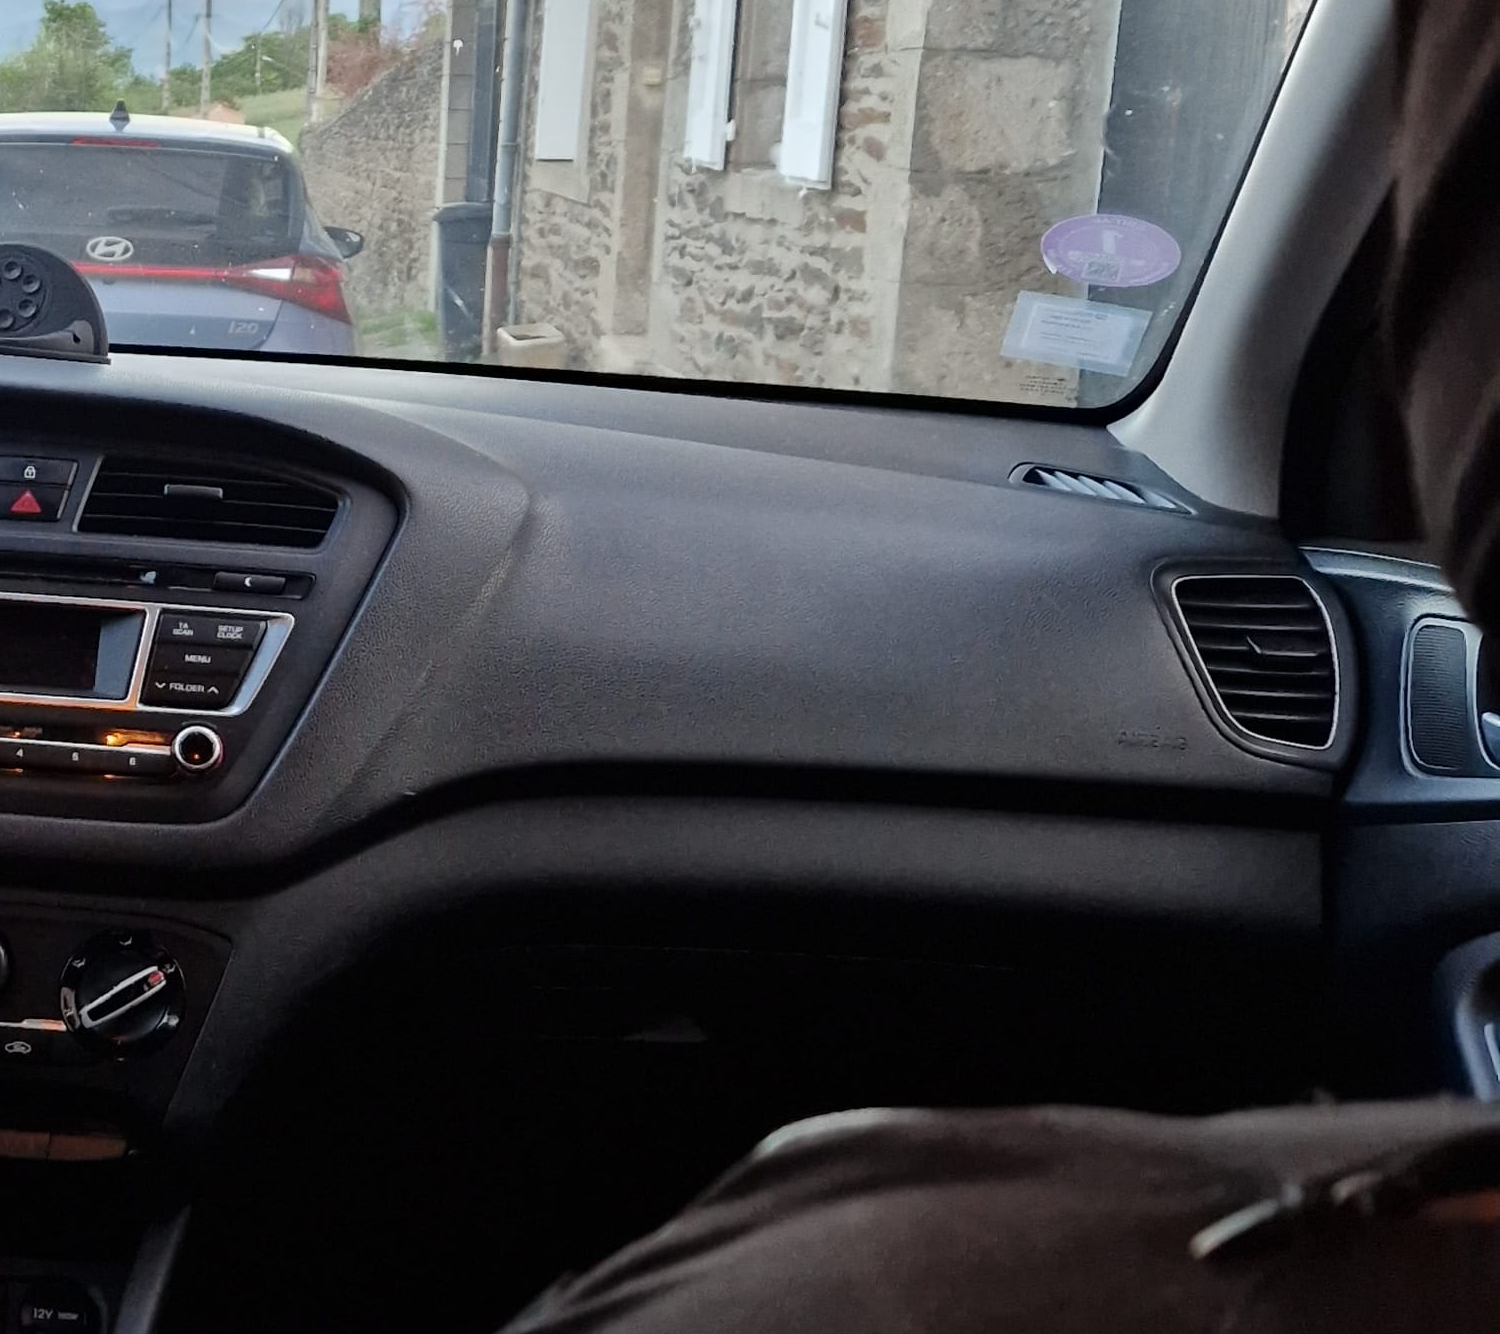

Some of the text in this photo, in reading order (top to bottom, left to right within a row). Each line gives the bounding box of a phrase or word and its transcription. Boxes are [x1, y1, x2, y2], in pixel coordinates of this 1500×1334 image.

[218, 625, 244, 633] SETUP
[216, 631, 242, 640] CLOCK
[184, 654, 211, 664] MENU
[169, 682, 205, 693] FOLDER
[16, 748, 24, 758] 4
